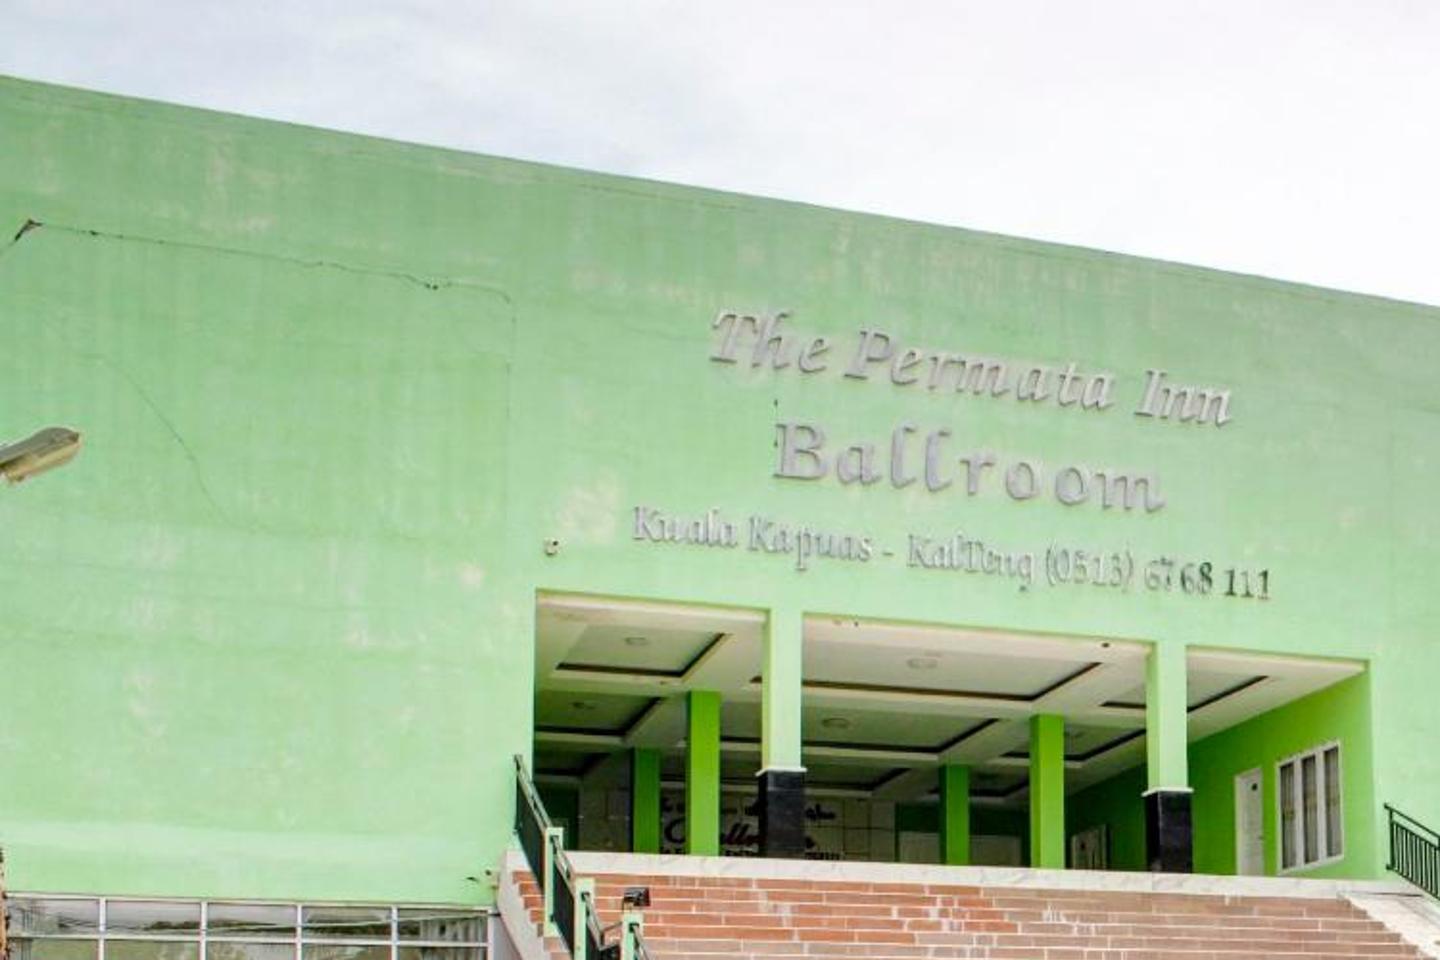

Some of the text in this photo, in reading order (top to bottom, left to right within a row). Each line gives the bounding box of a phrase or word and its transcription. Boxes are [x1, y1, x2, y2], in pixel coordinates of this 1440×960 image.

[709, 310, 1233, 428] The Permata Inn
[773, 421, 1166, 513] Ballroom
[633, 505, 738, 548] Kuala
[748, 515, 873, 572] Kapuas
[906, 530, 1035, 593] KalTeng
[1045, 542, 1134, 593] (0513)
[1144, 556, 1213, 595] 6768
[1224, 568, 1271, 600] 111
